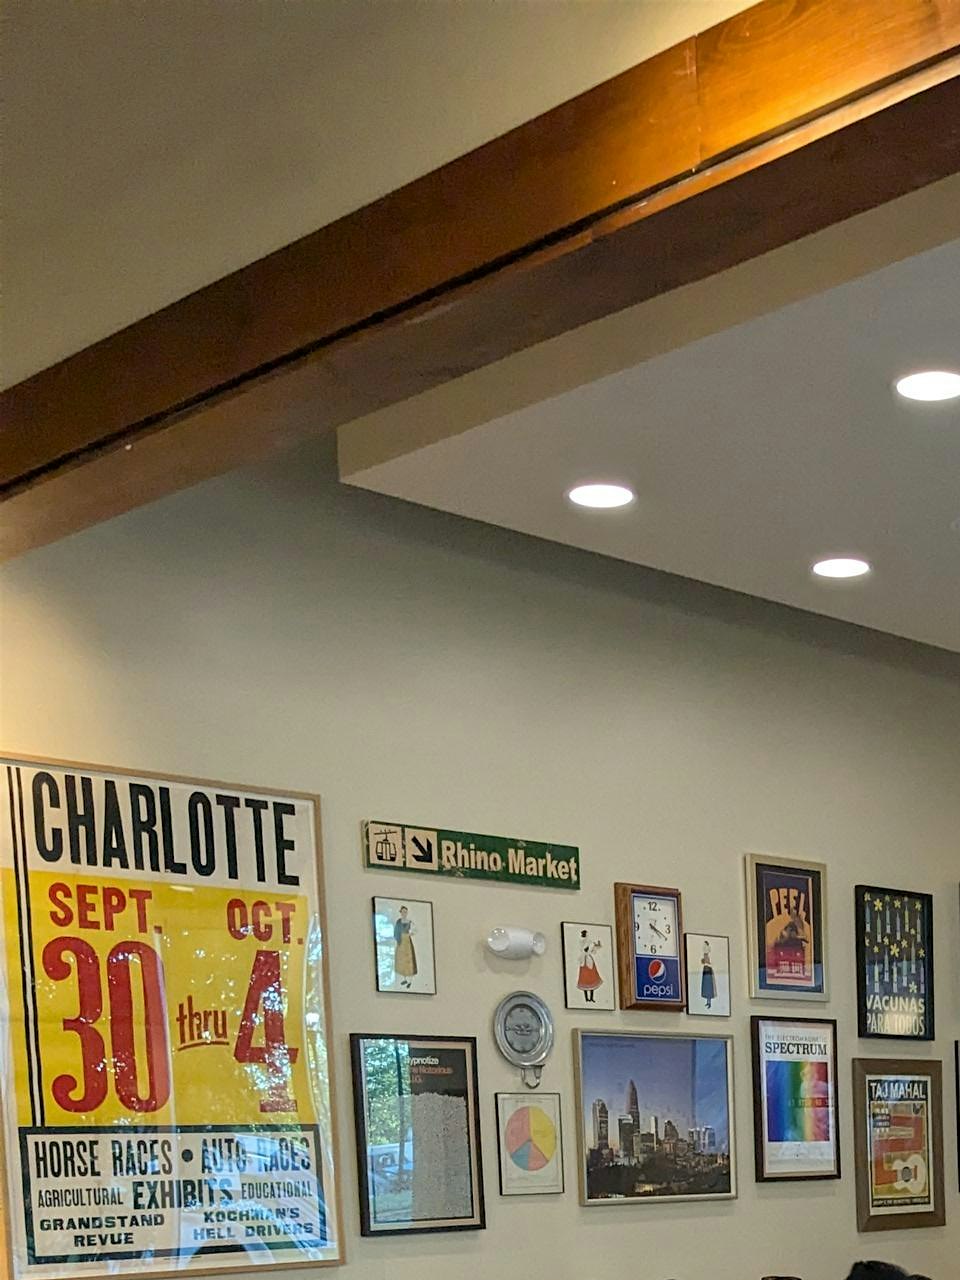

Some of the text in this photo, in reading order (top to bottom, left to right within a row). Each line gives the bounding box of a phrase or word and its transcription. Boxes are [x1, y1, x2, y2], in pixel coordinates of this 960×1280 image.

[32, 771, 300, 886] CHARLOTTE
[441, 840, 578, 881] Rhino Market
[48, 882, 304, 945] SEPT. OCT.
[648, 902, 658, 912] 12
[634, 922, 671, 934] 9 3
[651, 945, 657, 954] 6
[644, 983, 673, 996] pepsi
[866, 994, 925, 1013] VACUNAS
[42, 936, 299, 1113] 30 thru 4
[866, 1012, 891, 1034] PARA
[765, 1041, 827, 1056] SPECTRUM
[870, 1082, 926, 1099] TAJ MAHAL
[34, 1140, 101, 1178] HORSE
[112, 1139, 172, 1177] RACES
[202, 1138, 247, 1174] AUTO
[38, 1178, 313, 1210] AGRICULTURAL EXHIBITS EDUCATIONAL
[40, 1207, 300, 1231] GRANDSTAND KOCHMAN'S
[74, 1223, 314, 1247] REVUE HELL DRIVERS
